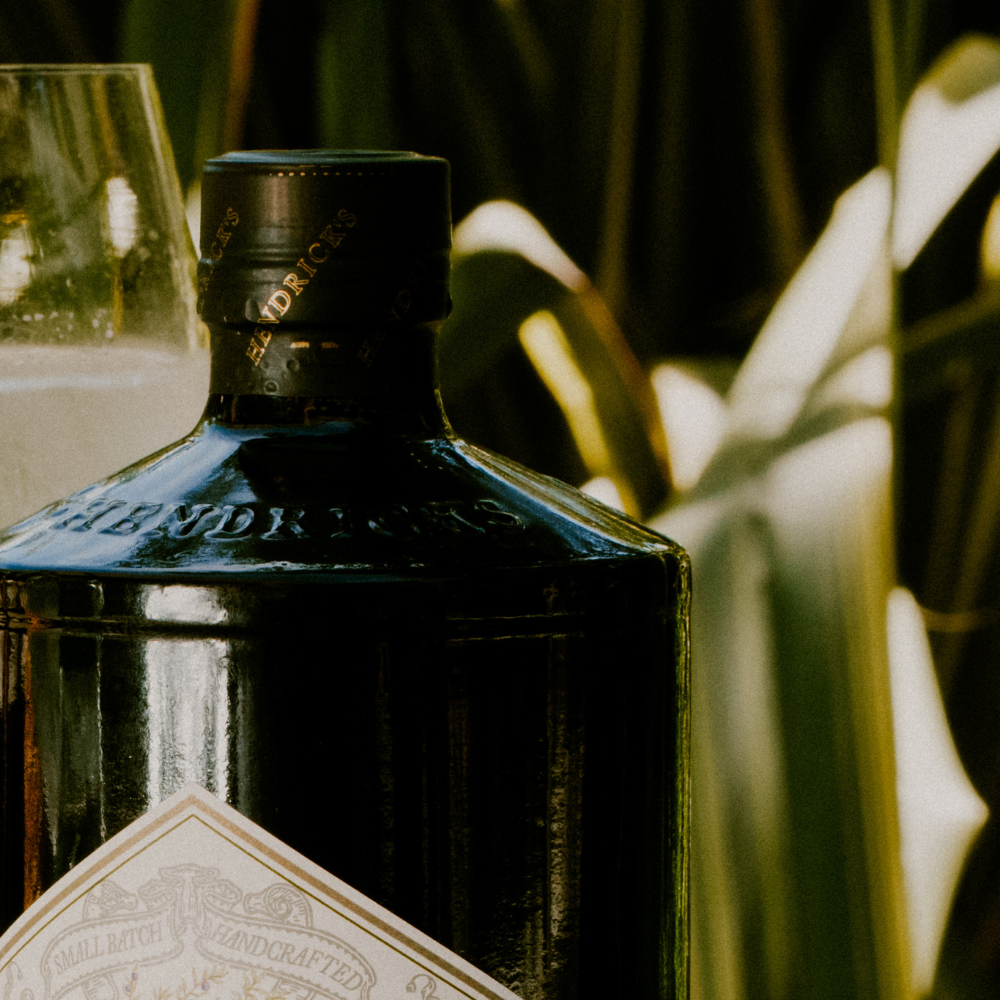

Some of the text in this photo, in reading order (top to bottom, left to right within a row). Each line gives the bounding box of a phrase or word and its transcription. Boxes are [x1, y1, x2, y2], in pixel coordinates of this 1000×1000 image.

[246, 208, 357, 366] HENDRICK'S
[53, 921, 365, 991] SMALL BATCH HANDCRAFTED
